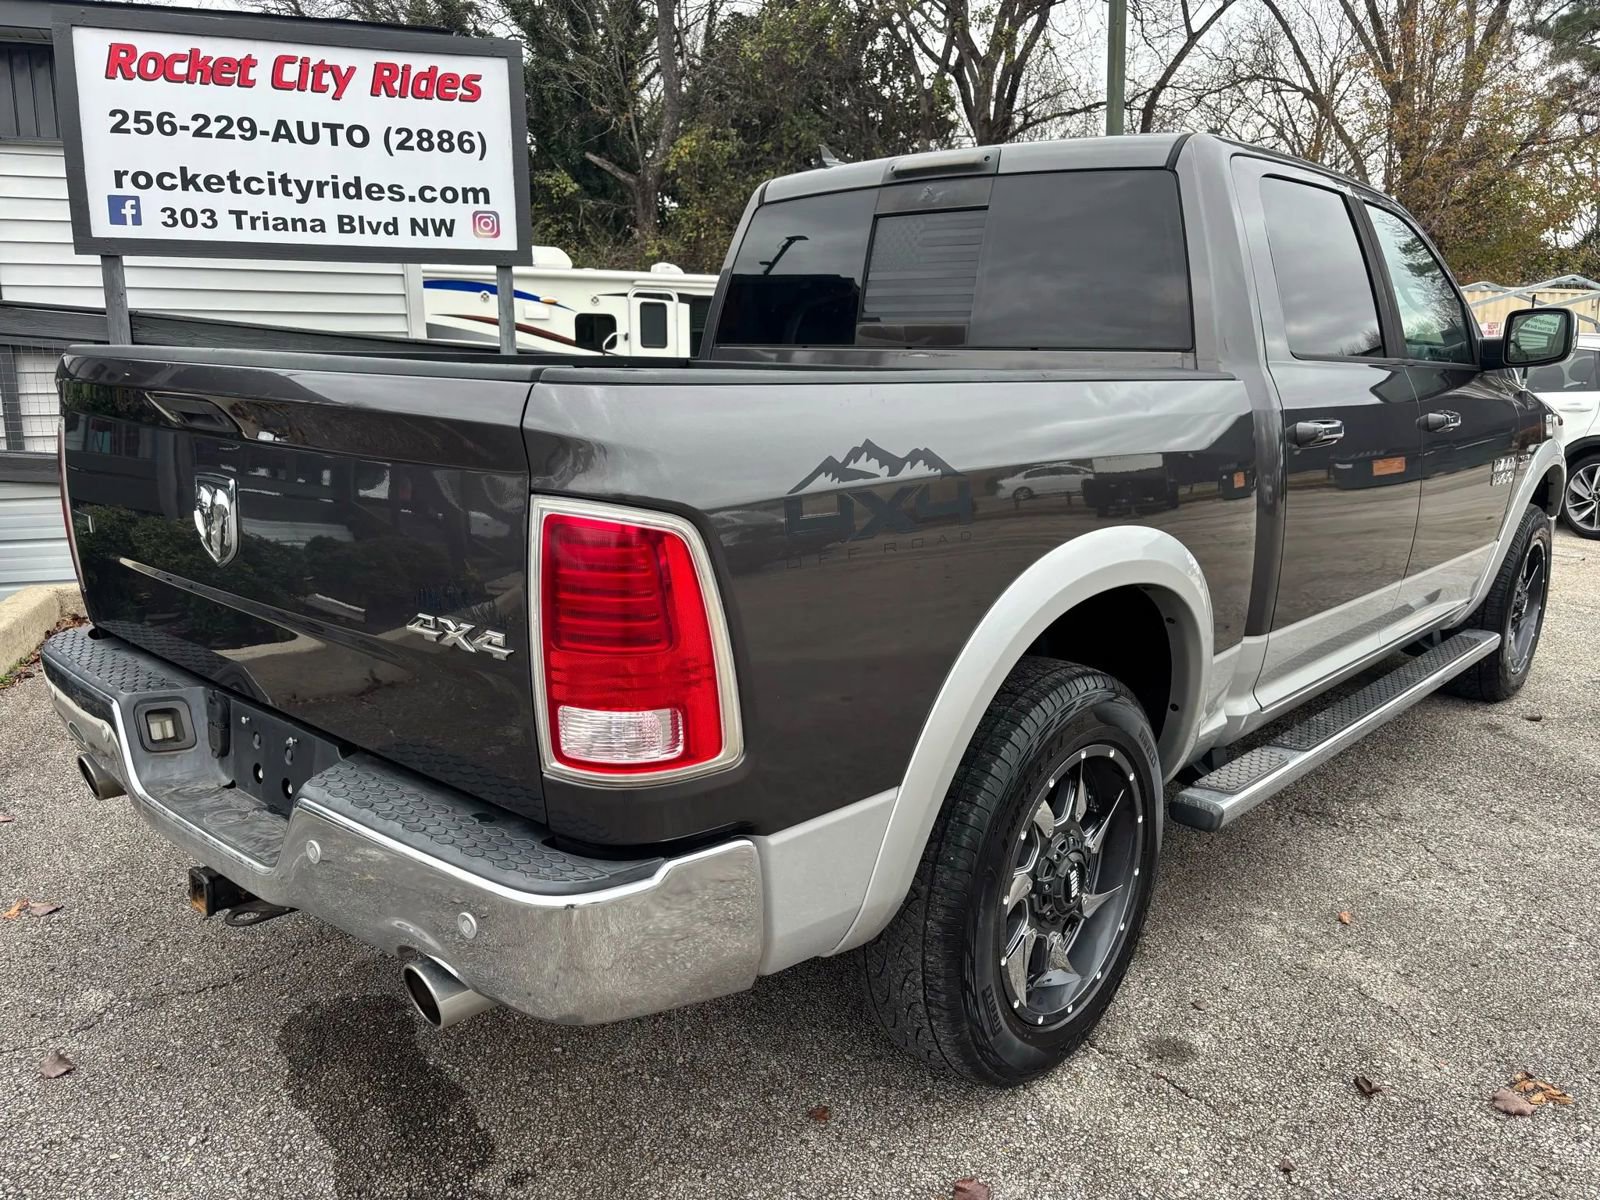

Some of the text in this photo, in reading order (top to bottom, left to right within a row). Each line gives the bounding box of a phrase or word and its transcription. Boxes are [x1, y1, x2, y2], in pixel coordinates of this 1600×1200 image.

[105, 43, 482, 102] Rocket City Rides
[108, 108, 487, 160] 256-229-AUTO (2886)
[114, 166, 491, 205] rocketcityrides.com
[160, 207, 456, 238] 303 Triana Blvd NW
